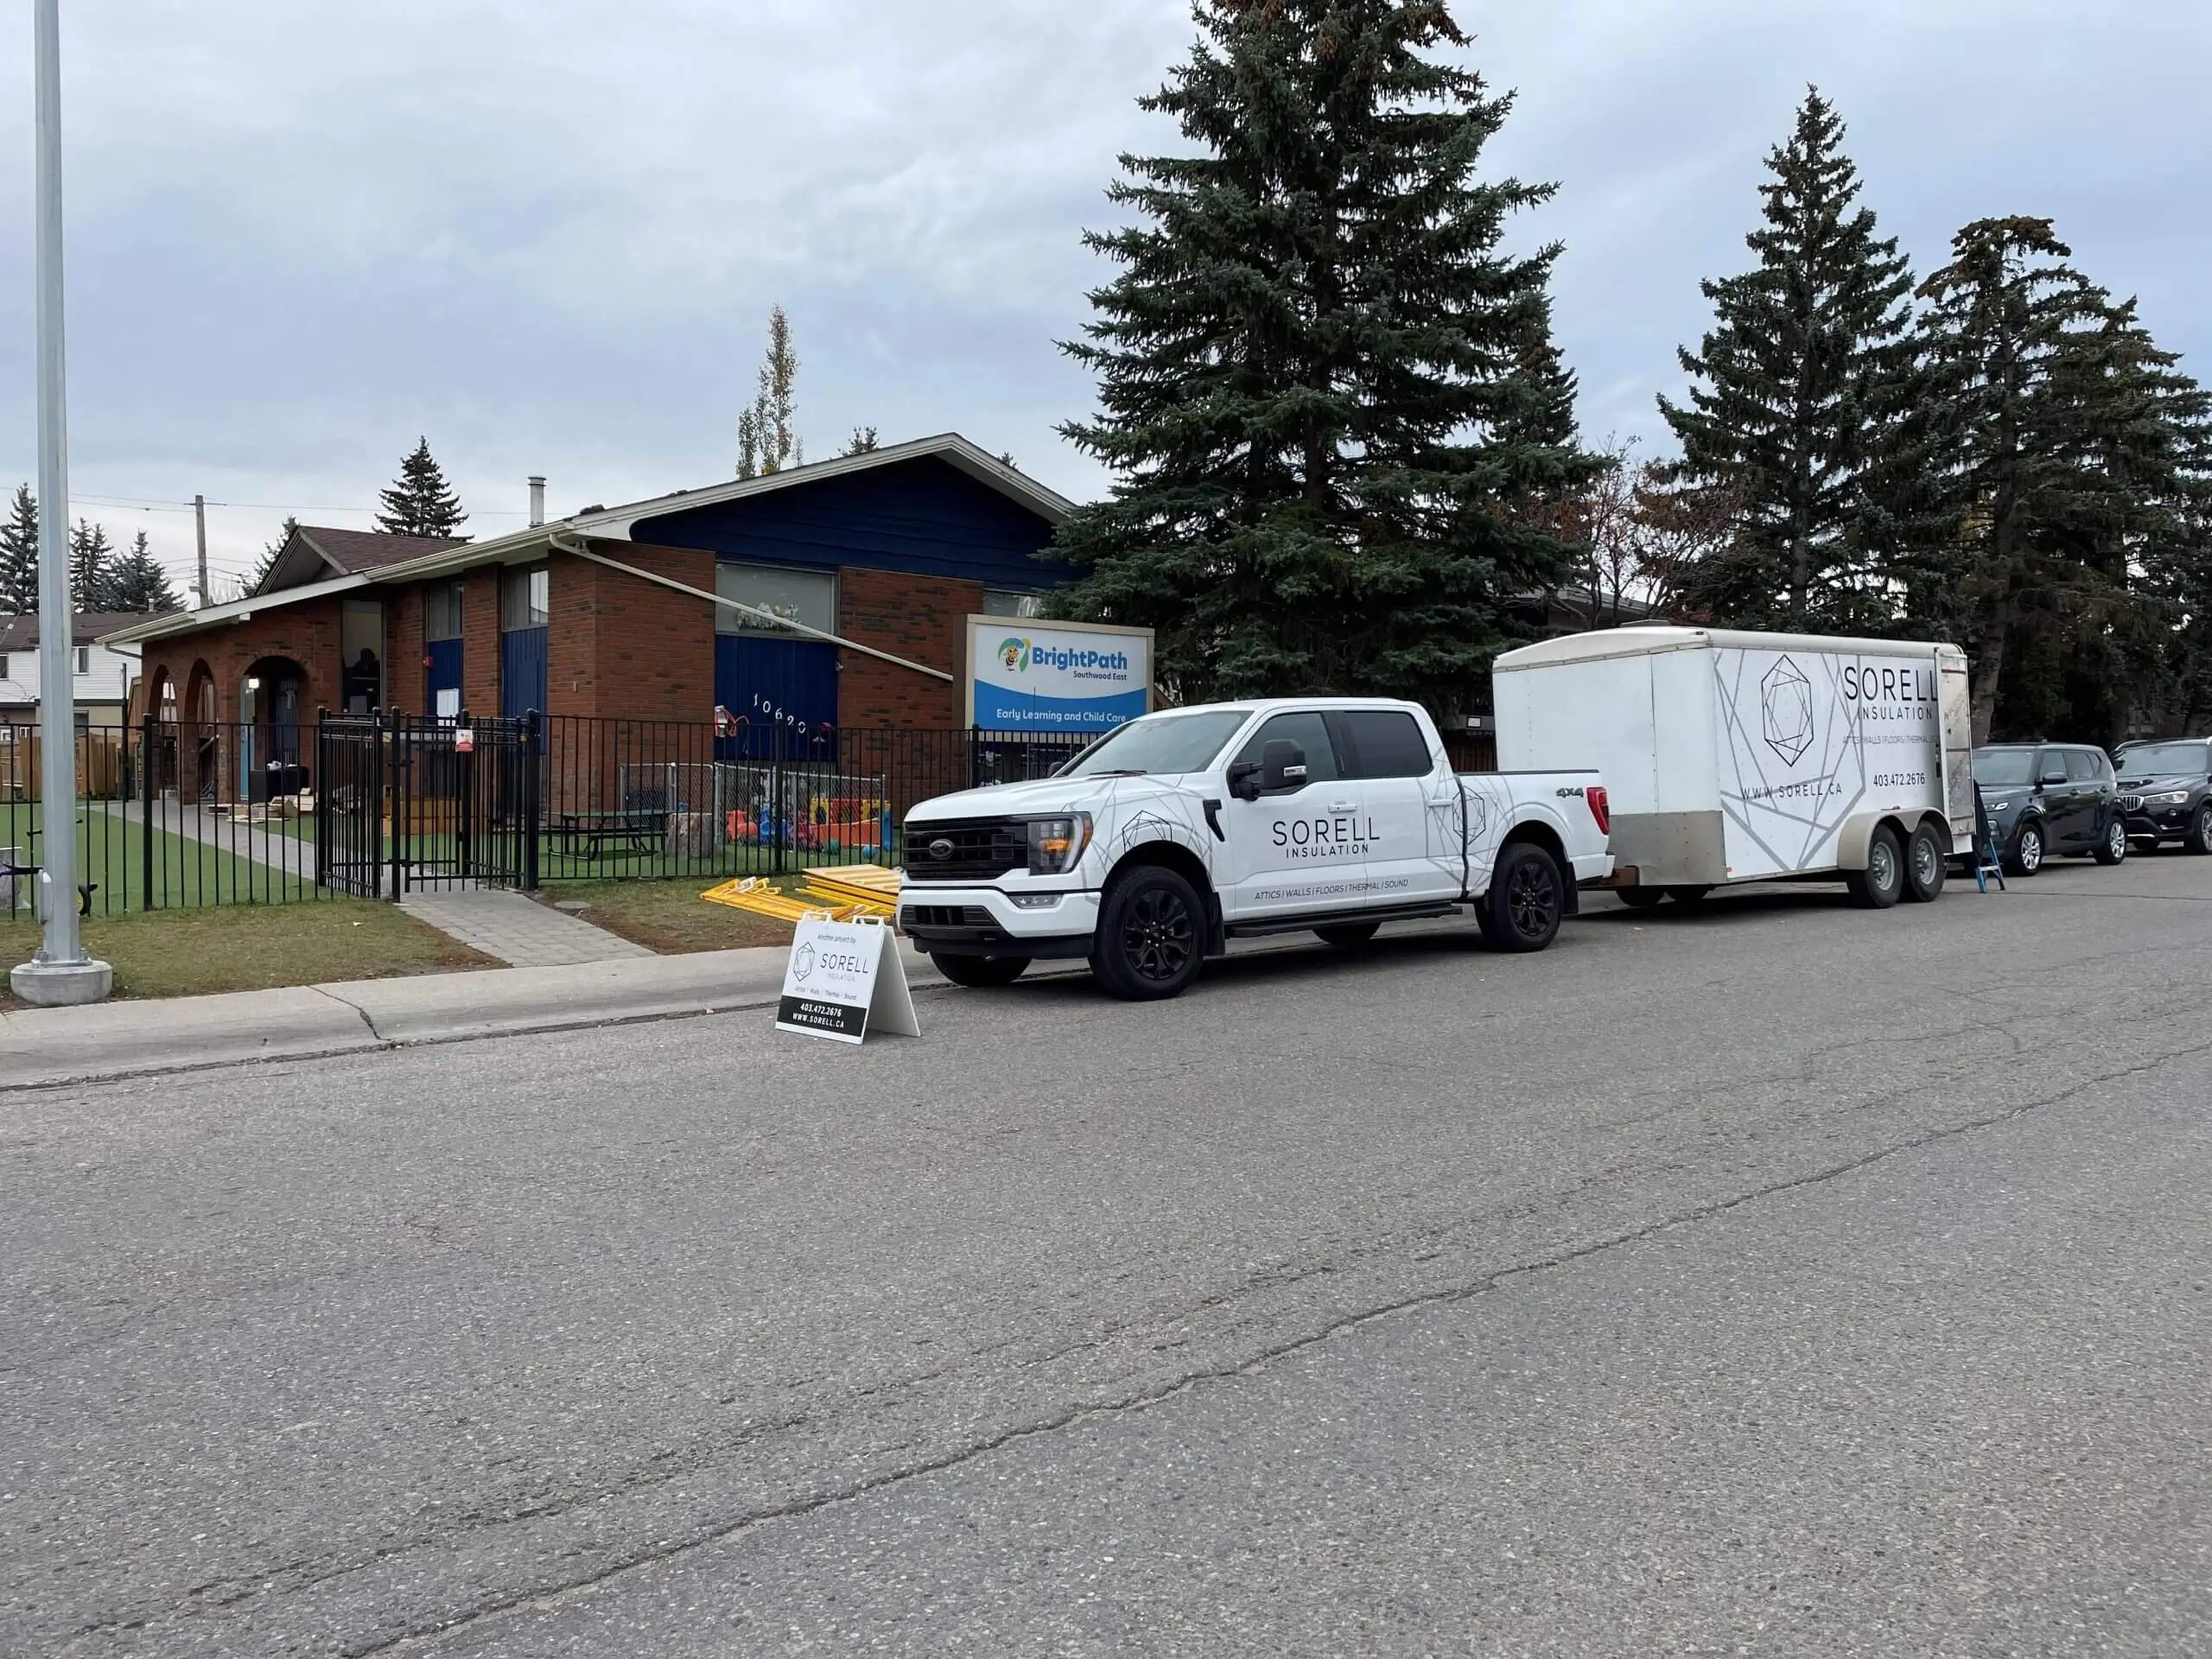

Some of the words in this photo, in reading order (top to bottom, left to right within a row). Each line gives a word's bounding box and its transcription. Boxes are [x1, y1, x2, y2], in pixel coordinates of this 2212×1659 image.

[1033, 646, 1128, 671] BrightPath
[1073, 671, 1111, 680] Southwood
[1113, 672, 1127, 681] East
[1844, 666, 1938, 702] SORELL
[997, 709, 1020, 721] Early
[1023, 709, 1062, 722] Learning
[1065, 711, 1080, 721] and
[1083, 711, 1104, 722] Child
[1106, 713, 1127, 723] Care
[1857, 706, 1933, 721] INSULATION
[1873, 772, 1926, 786] 403.472.2676
[1741, 782, 1843, 800] WWW.SORELL.CA
[1272, 817, 1381, 846] SORELL
[1286, 844, 1369, 858] INSULATION
[1255, 890, 1281, 899] ATTICS
[1287, 887, 1311, 898] WALLS
[1316, 885, 1344, 895] FLOORS
[1349, 882, 1382, 893] THERMAL
[1384, 879, 1408, 889] SOUND
[821, 954, 868, 973] SORELL
[800, 1003, 842, 1017] 403.472.2676
[793, 1014, 843, 1028] WWW.SORELL.CA
